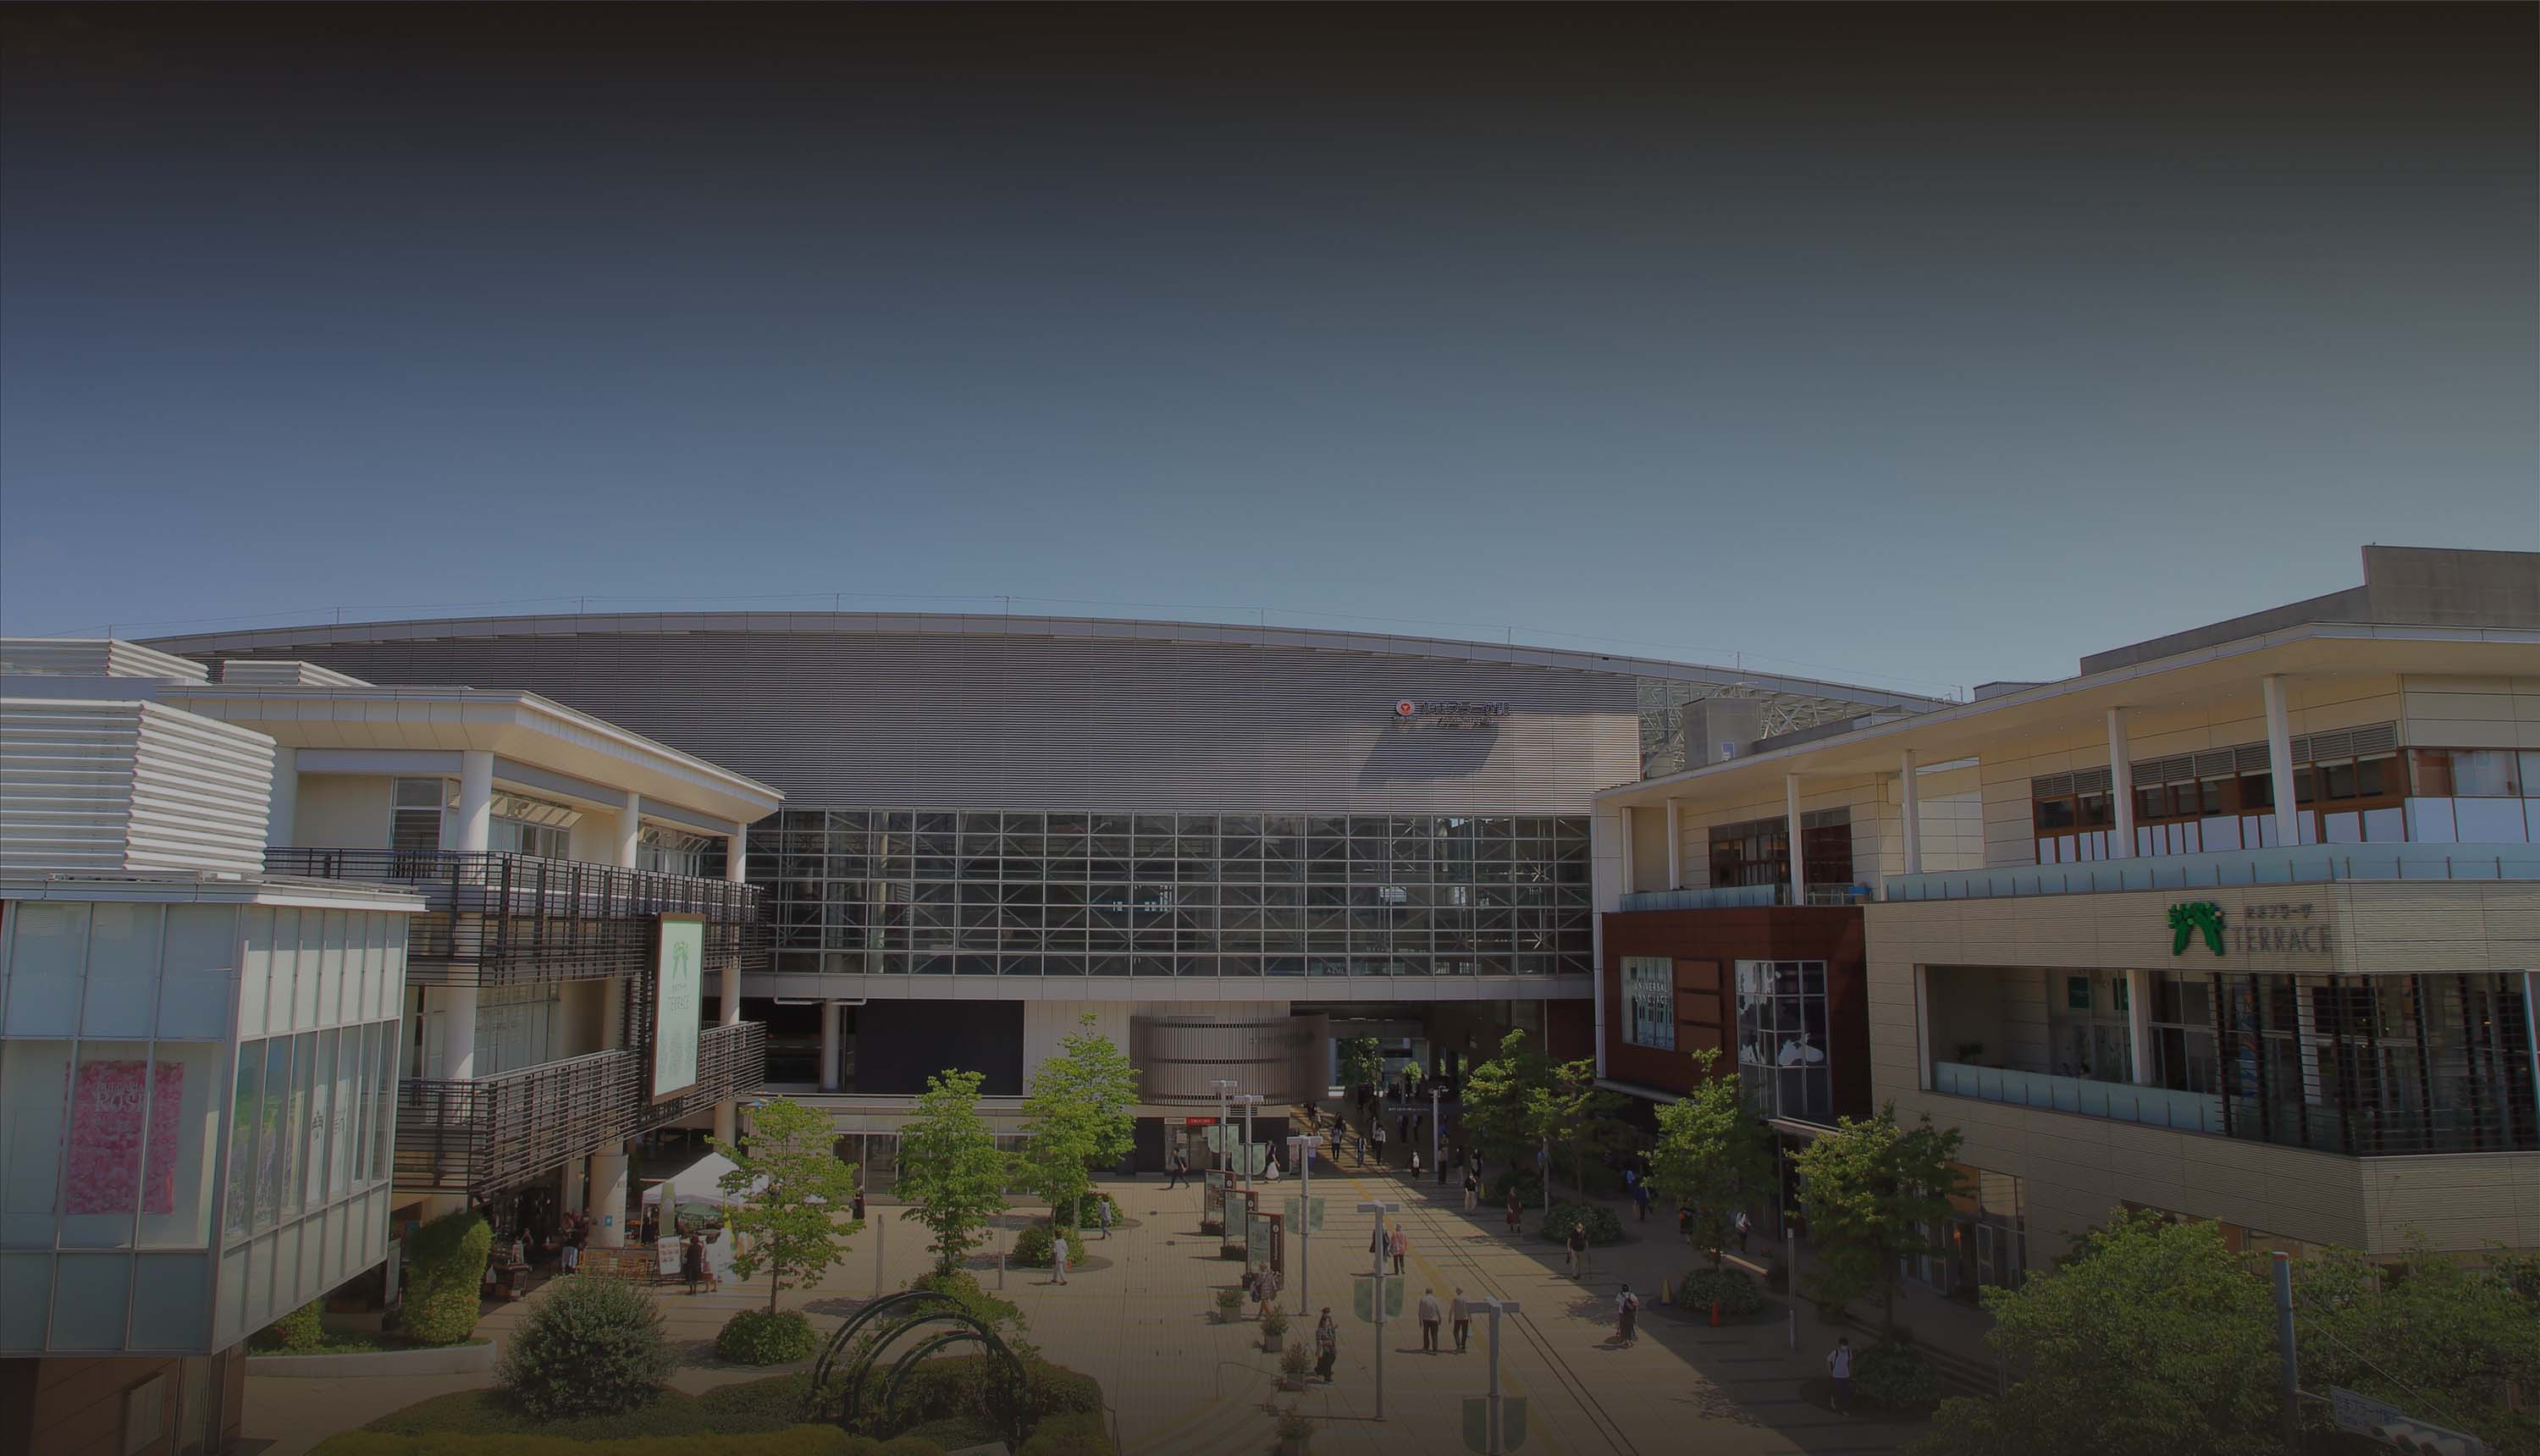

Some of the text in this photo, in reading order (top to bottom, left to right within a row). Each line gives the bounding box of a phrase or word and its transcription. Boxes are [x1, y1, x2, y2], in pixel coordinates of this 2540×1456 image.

[2230, 925, 2330, 953] TERRACE
[1633, 981, 1667, 992] UNIVERSAL
[1635, 995, 1668, 1005] LANGUAGE
